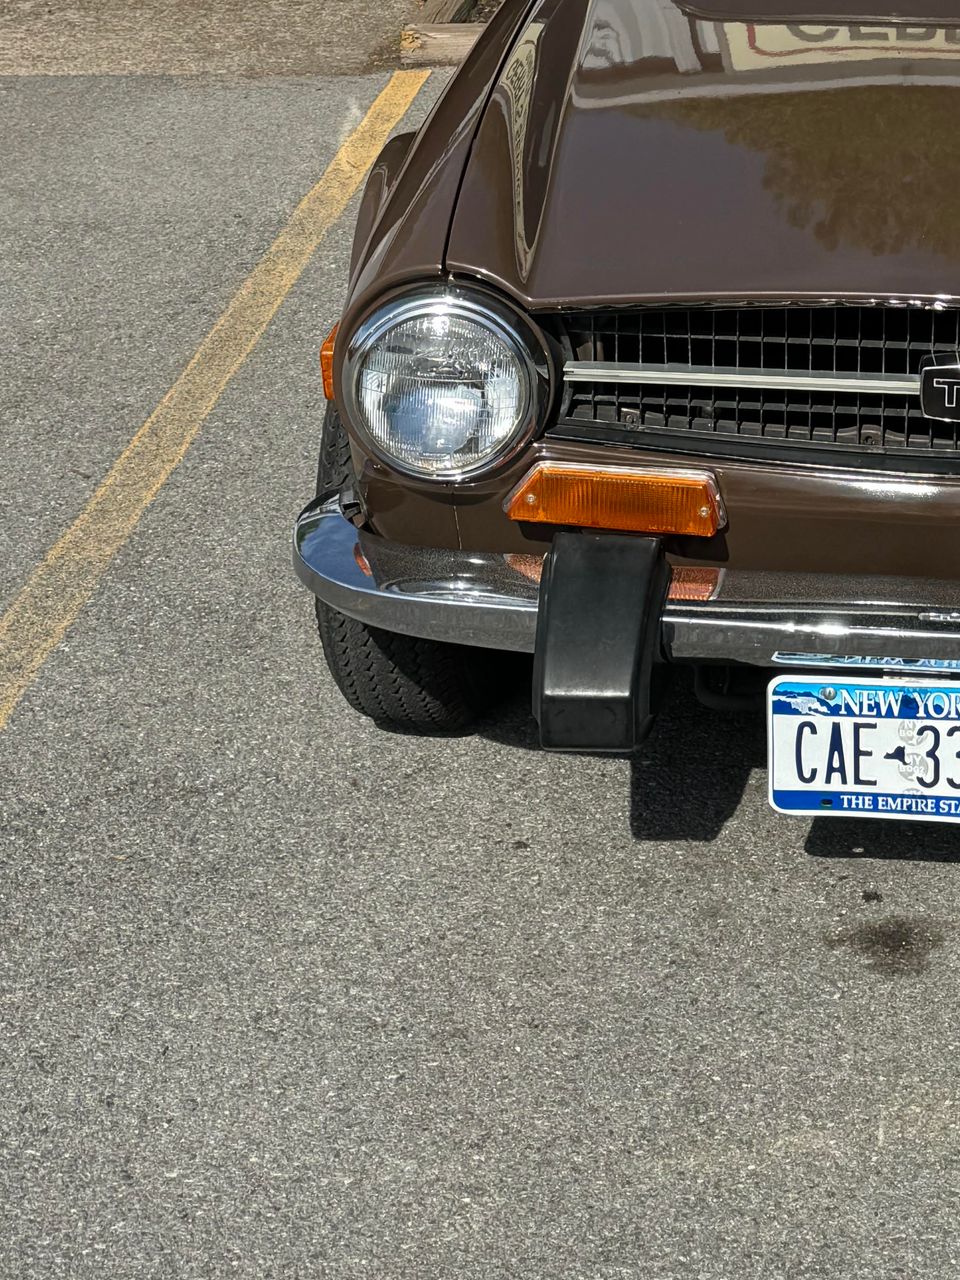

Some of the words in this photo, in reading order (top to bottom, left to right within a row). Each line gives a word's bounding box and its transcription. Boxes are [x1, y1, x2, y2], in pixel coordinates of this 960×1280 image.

[840, 688, 905, 717] NEW
[795, 721, 878, 786] CAE
[840, 795, 875, 810] THE
[877, 797, 937, 814] EMPIRE
